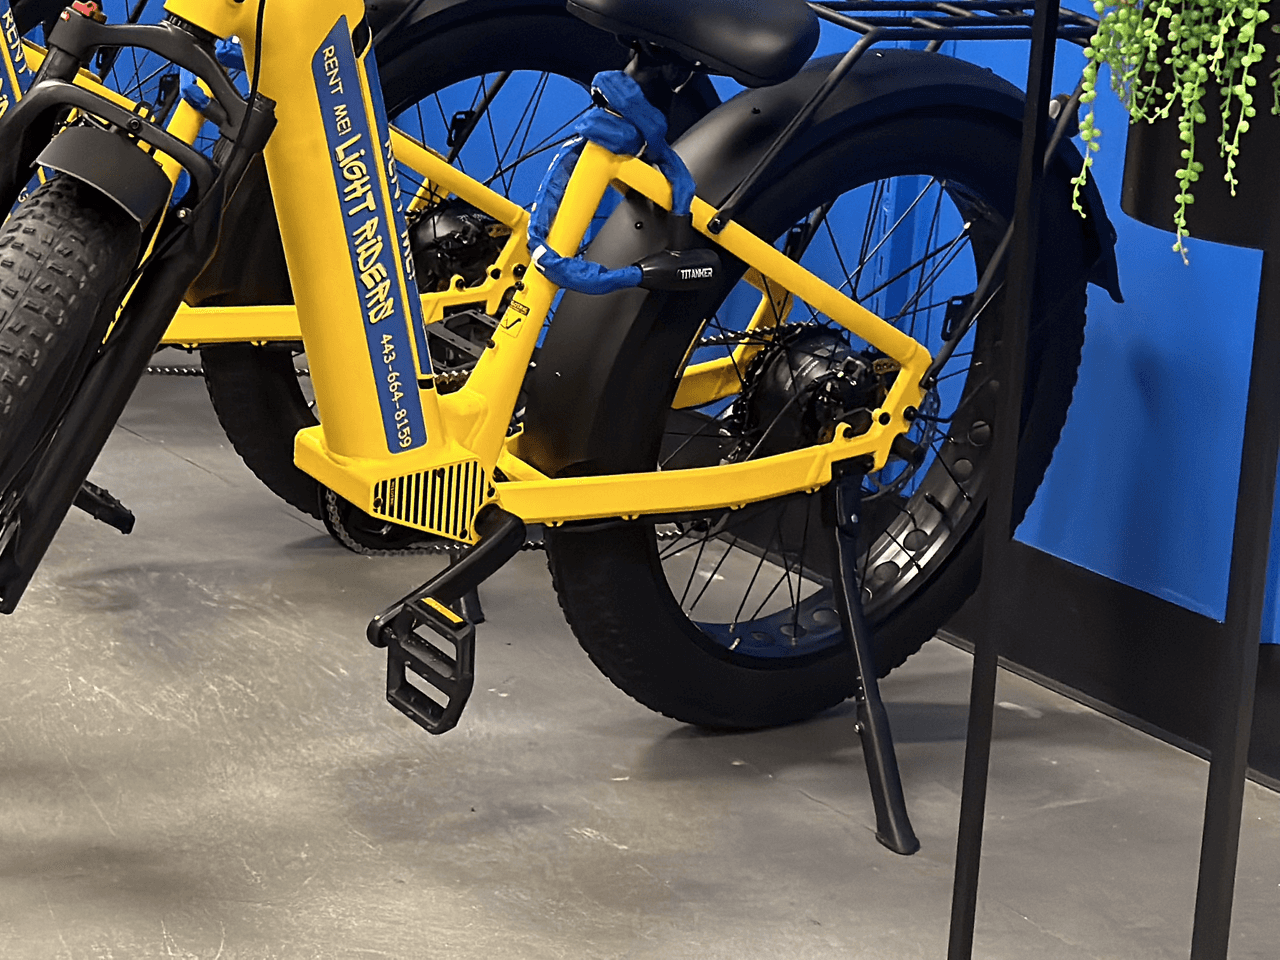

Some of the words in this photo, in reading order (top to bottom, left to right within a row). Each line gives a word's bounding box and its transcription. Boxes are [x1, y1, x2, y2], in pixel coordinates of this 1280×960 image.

[322, 44, 344, 95] RENT
[333, 103, 352, 137] ME!
[379, 333, 413, 450] 443-664-8159
[680, 267, 713, 280] TITANKER
